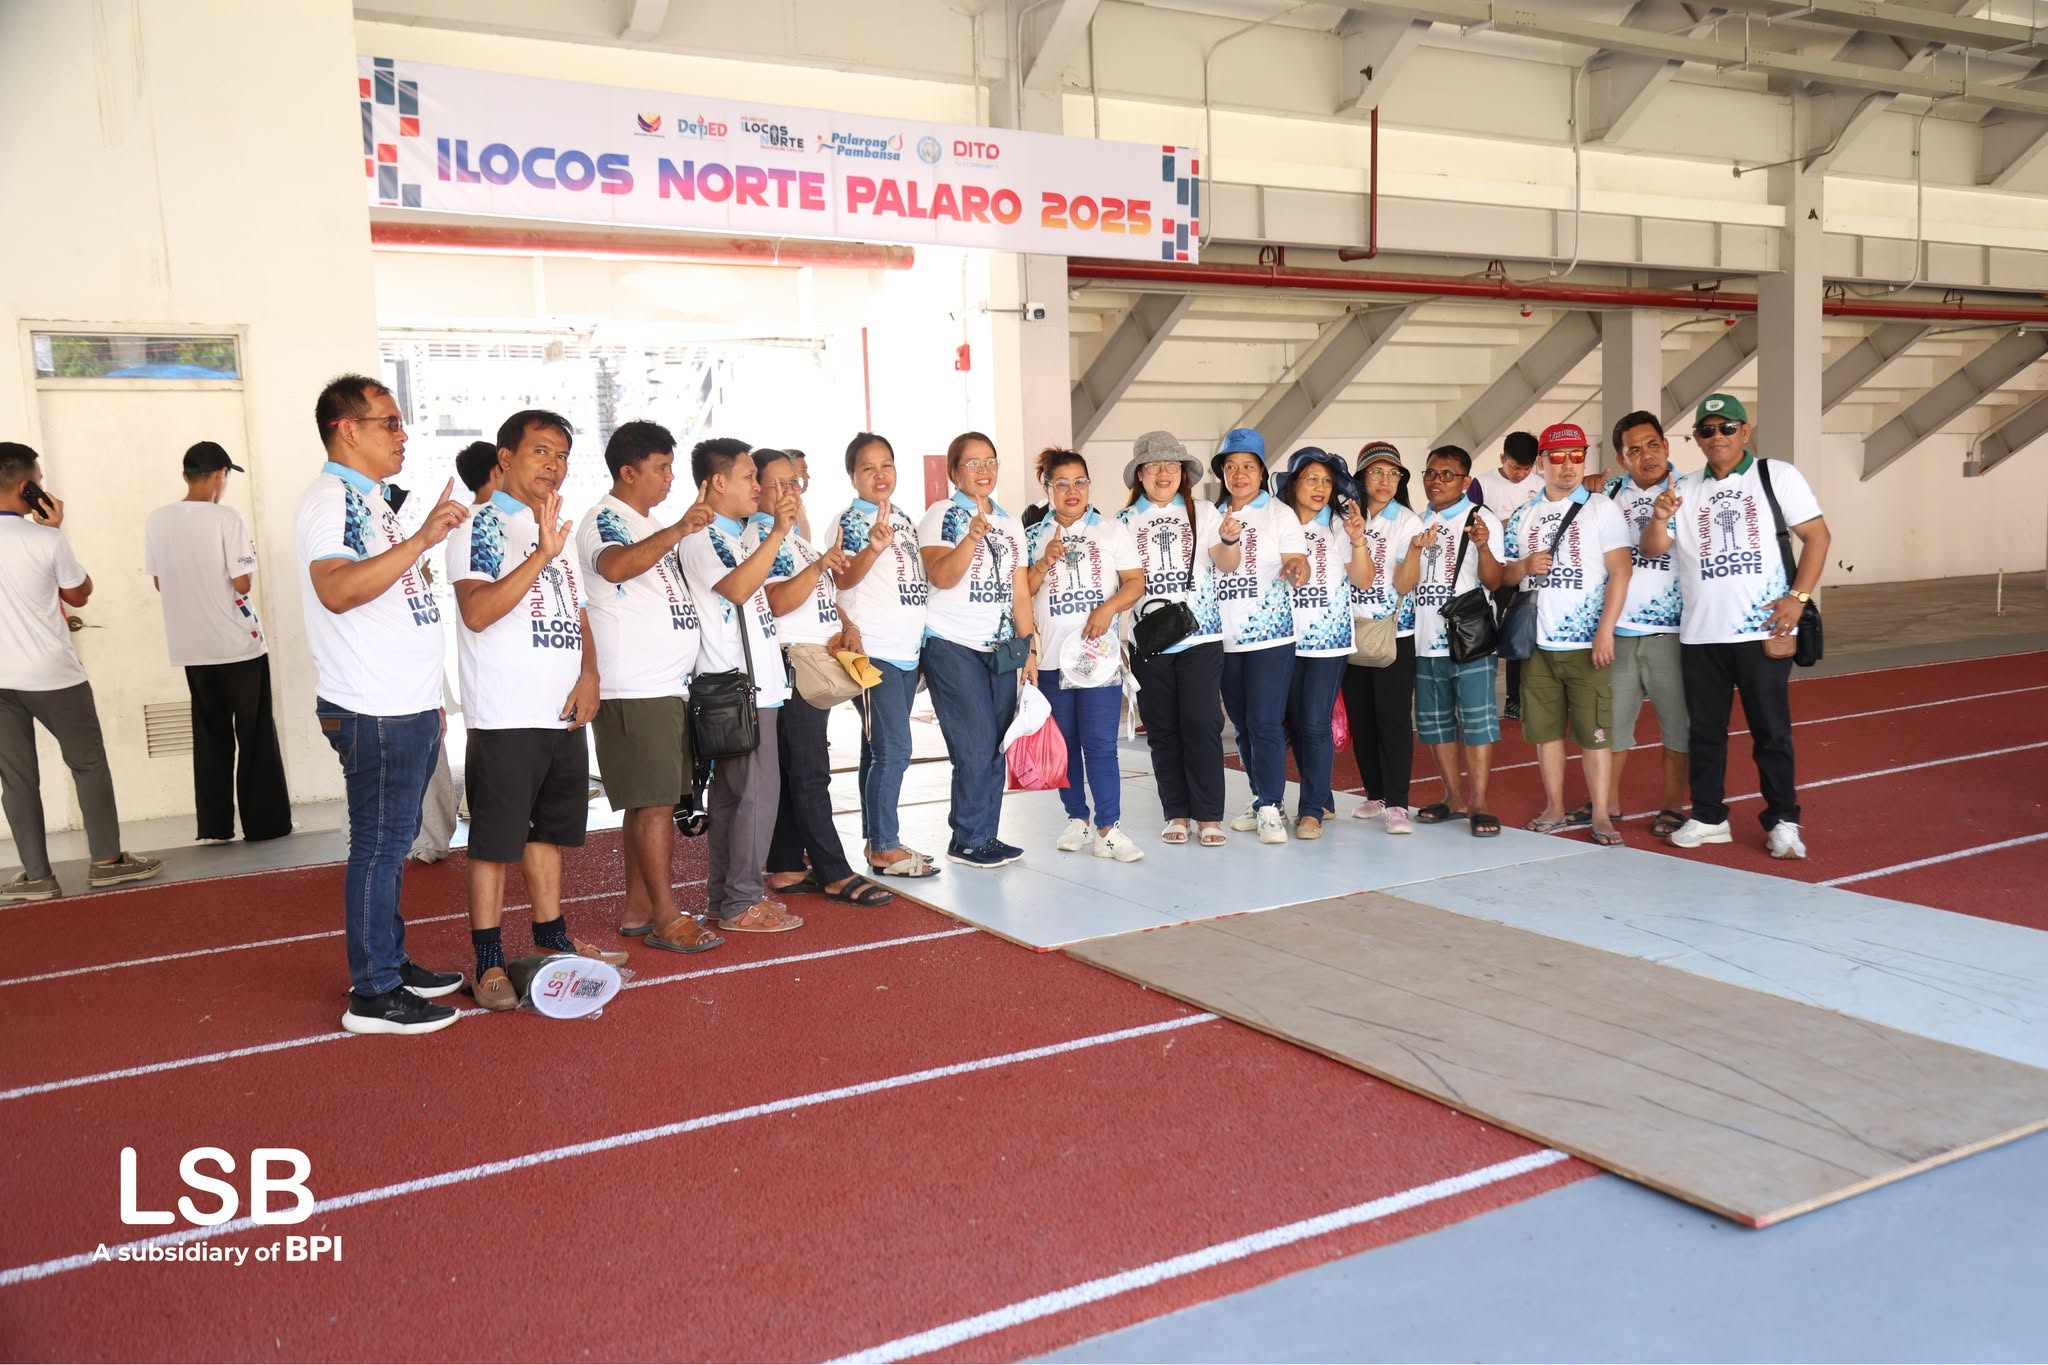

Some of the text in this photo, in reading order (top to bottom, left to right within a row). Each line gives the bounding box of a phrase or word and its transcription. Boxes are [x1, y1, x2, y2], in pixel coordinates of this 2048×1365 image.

[831, 132, 888, 150] Palarong
[953, 140, 1000, 160] DITO
[836, 145, 901, 161] Pambansa
[436, 137, 1152, 235] ILOCOS NORTE PALARO 2025
[1709, 489, 1743, 505] 2025
[1148, 517, 1181, 528] 2025
[1700, 550, 1762, 569] ILOCOS
[1701, 562, 1763, 580] NORTE
[1049, 589, 1104, 605] ILOCOS
[412, 607, 442, 627] NO
